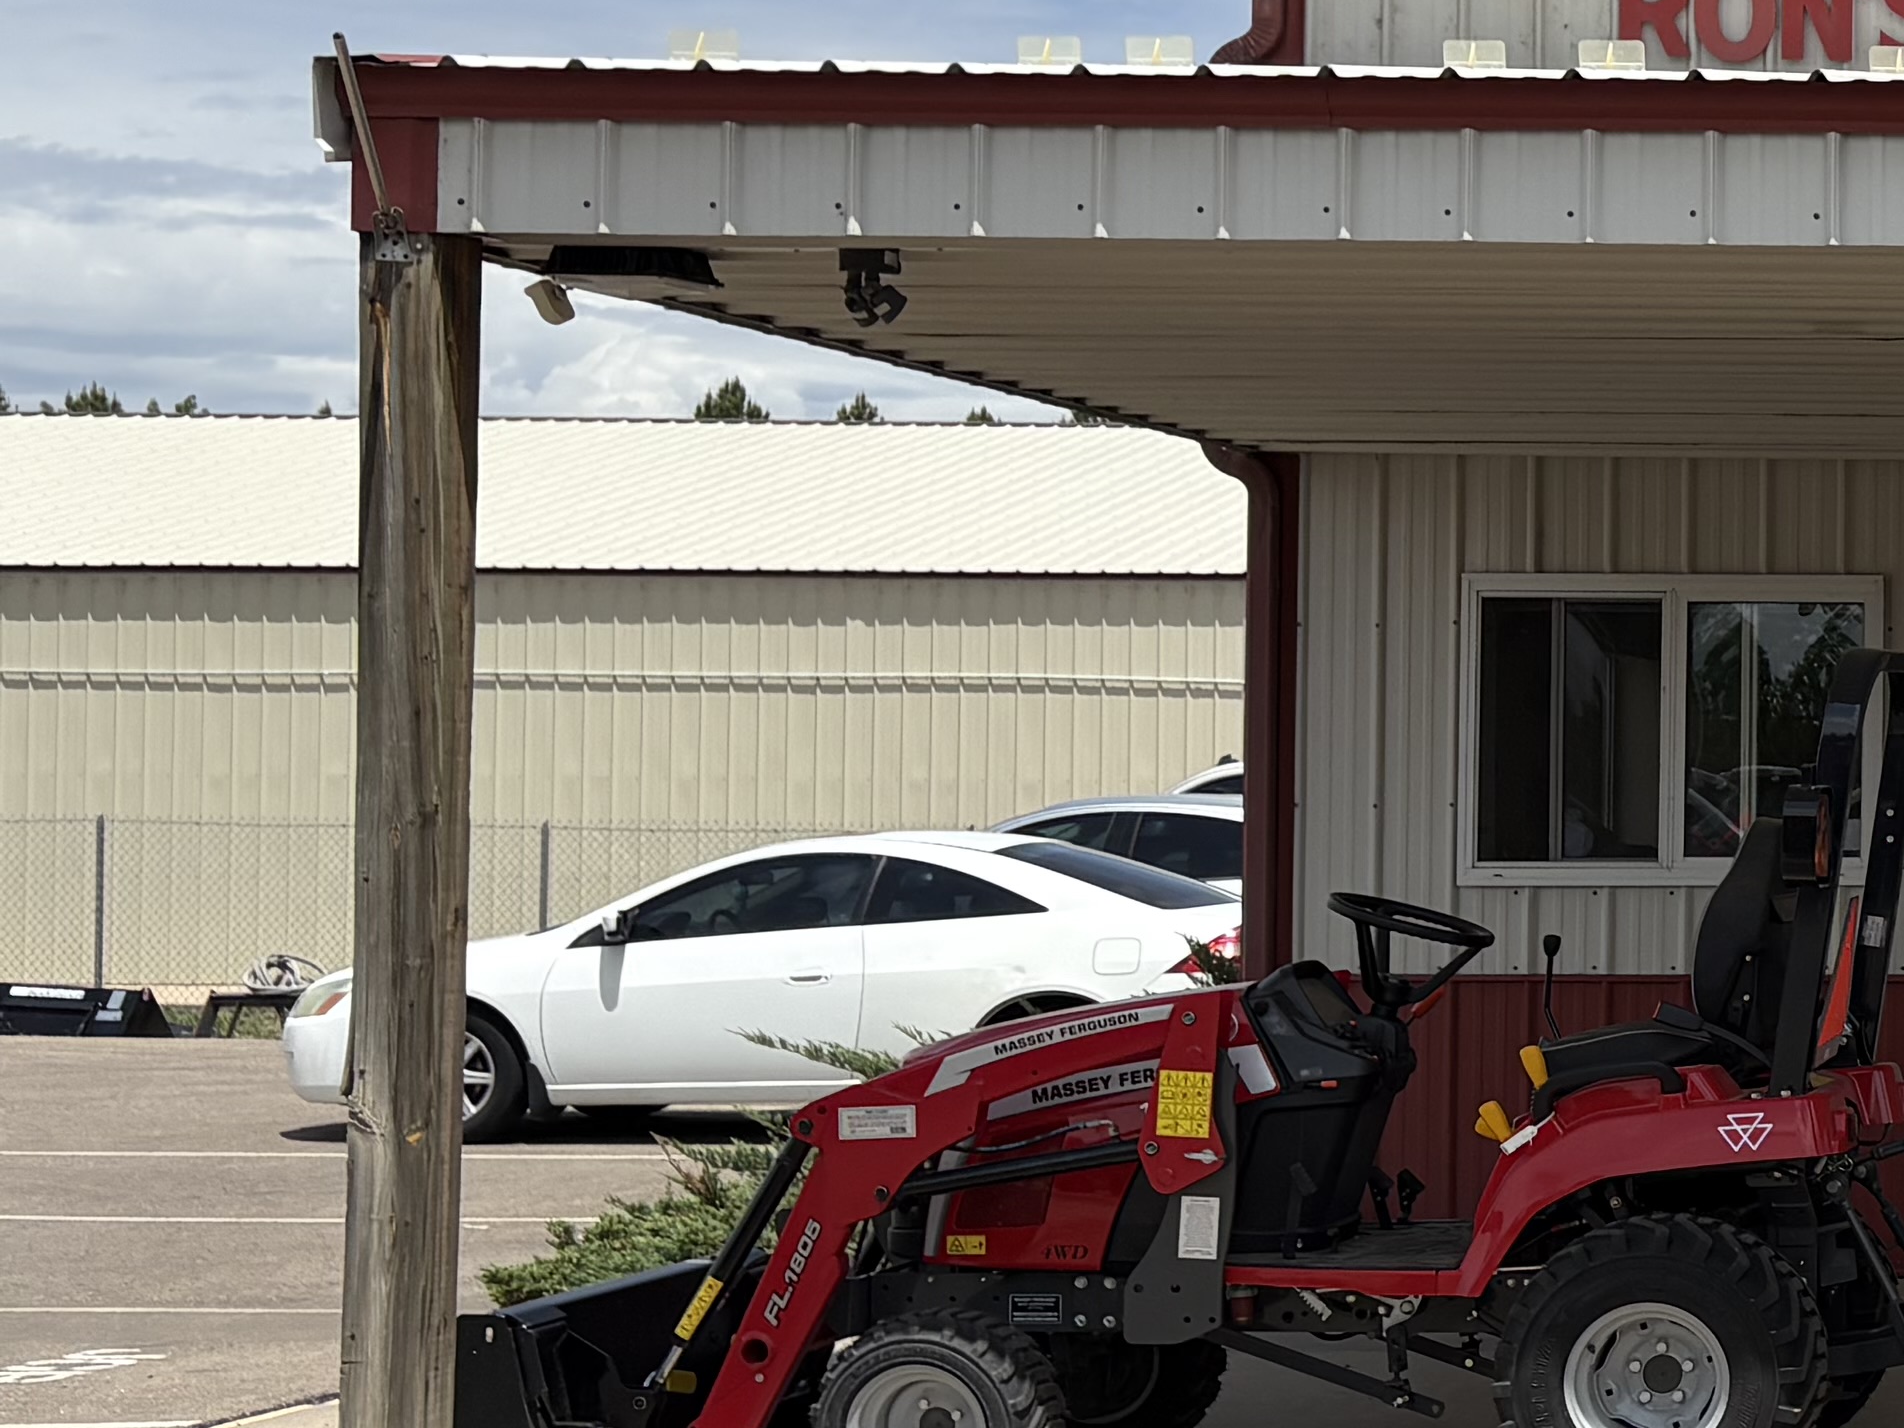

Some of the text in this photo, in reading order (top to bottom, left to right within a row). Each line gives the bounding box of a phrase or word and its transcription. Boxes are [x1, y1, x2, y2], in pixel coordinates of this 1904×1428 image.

[994, 1012, 1139, 1055] MASSEY FERGUSON
[1031, 1068, 1155, 1104] MASSEY FER
